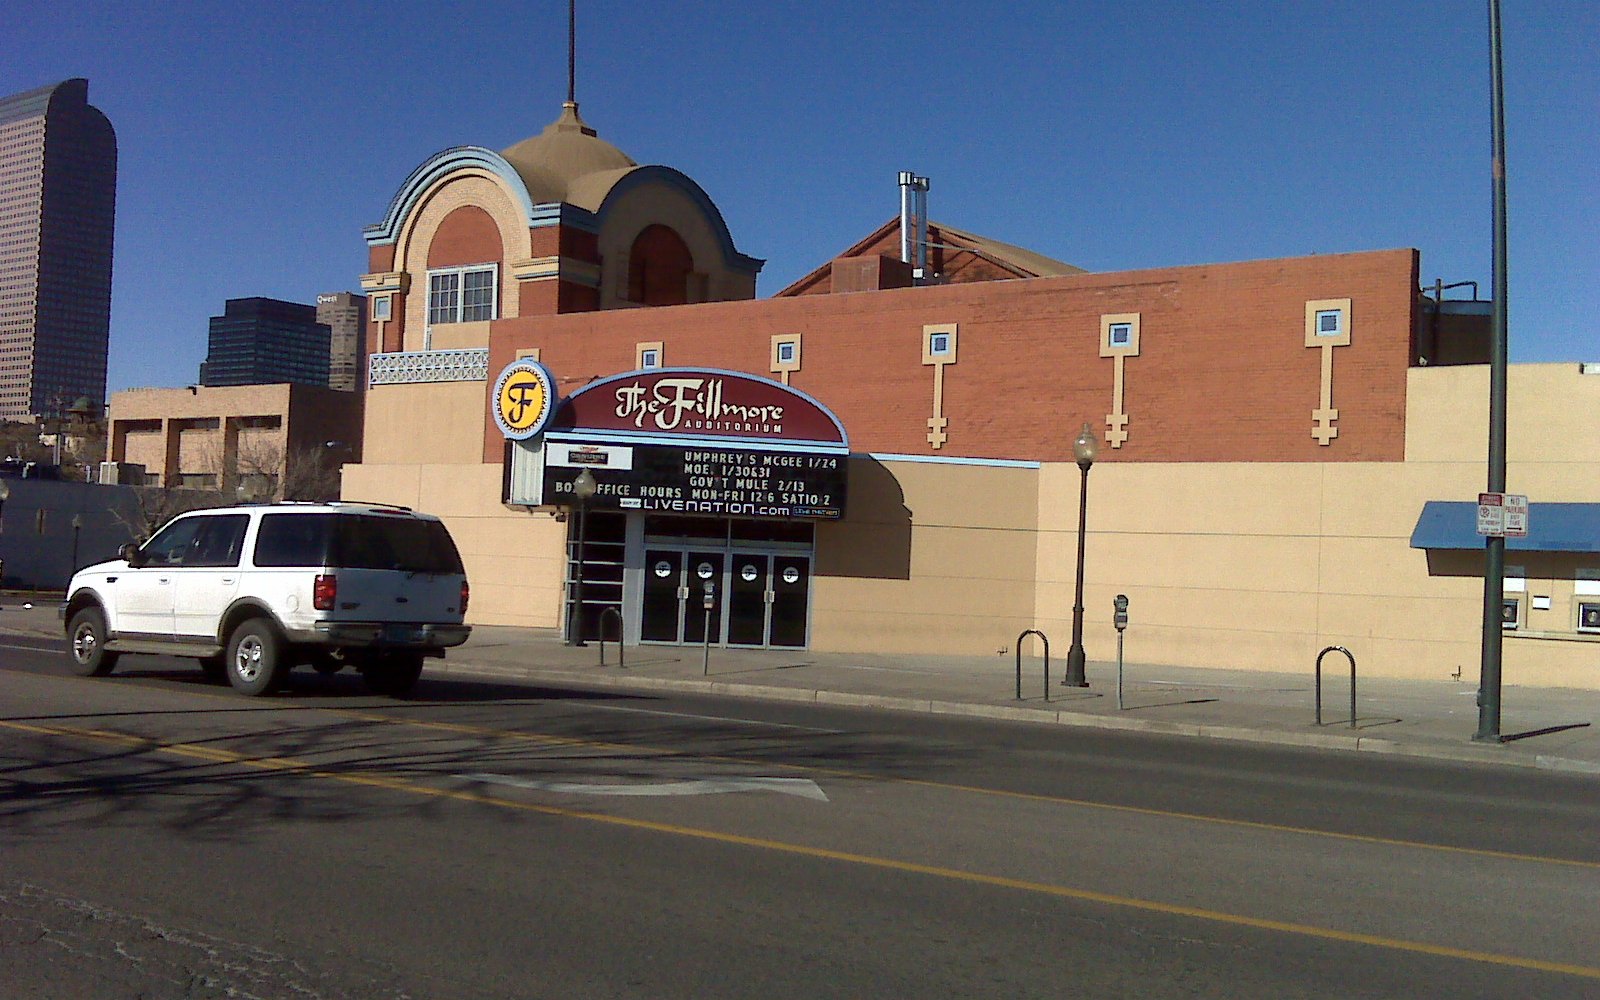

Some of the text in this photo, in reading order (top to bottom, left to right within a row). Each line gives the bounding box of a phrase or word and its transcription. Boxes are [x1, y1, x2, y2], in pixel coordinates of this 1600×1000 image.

[508, 382, 537, 423] F
[615, 378, 784, 430] The Fillmore
[684, 419, 783, 434] AUDITORIUM
[763, 455, 803, 467] MCGEE
[808, 457, 837, 469] 1/24
[555, 481, 576, 494] BO
[592, 483, 631, 496] FFICE
[640, 485, 682, 499] HOURS
[691, 488, 745, 502] MON-FRI
[736, 478, 769, 490] MULE
[777, 480, 805, 492] 2/13
